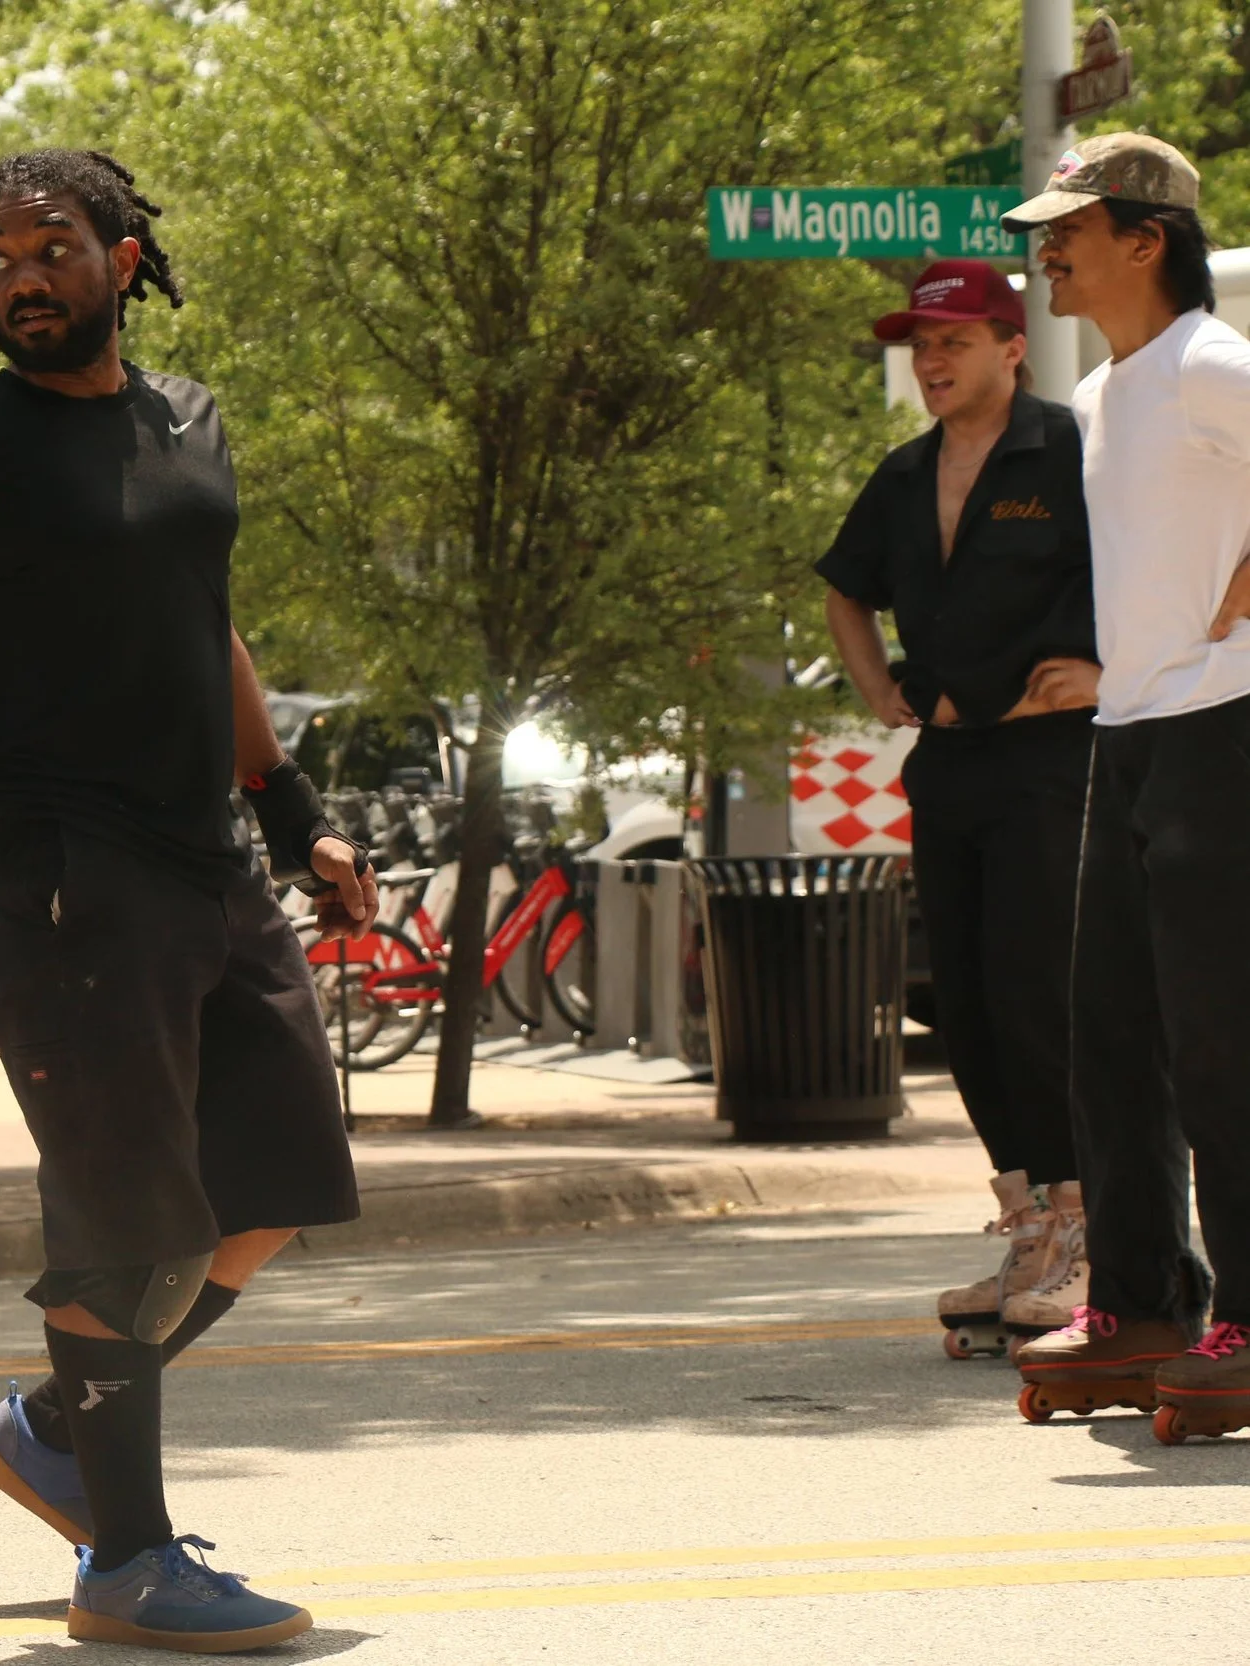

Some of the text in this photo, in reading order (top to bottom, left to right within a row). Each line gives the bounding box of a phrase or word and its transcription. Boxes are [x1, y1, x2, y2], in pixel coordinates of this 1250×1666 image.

[720, 189, 1000, 256] W Magnolia Av
[959, 225, 1015, 254] 1450
